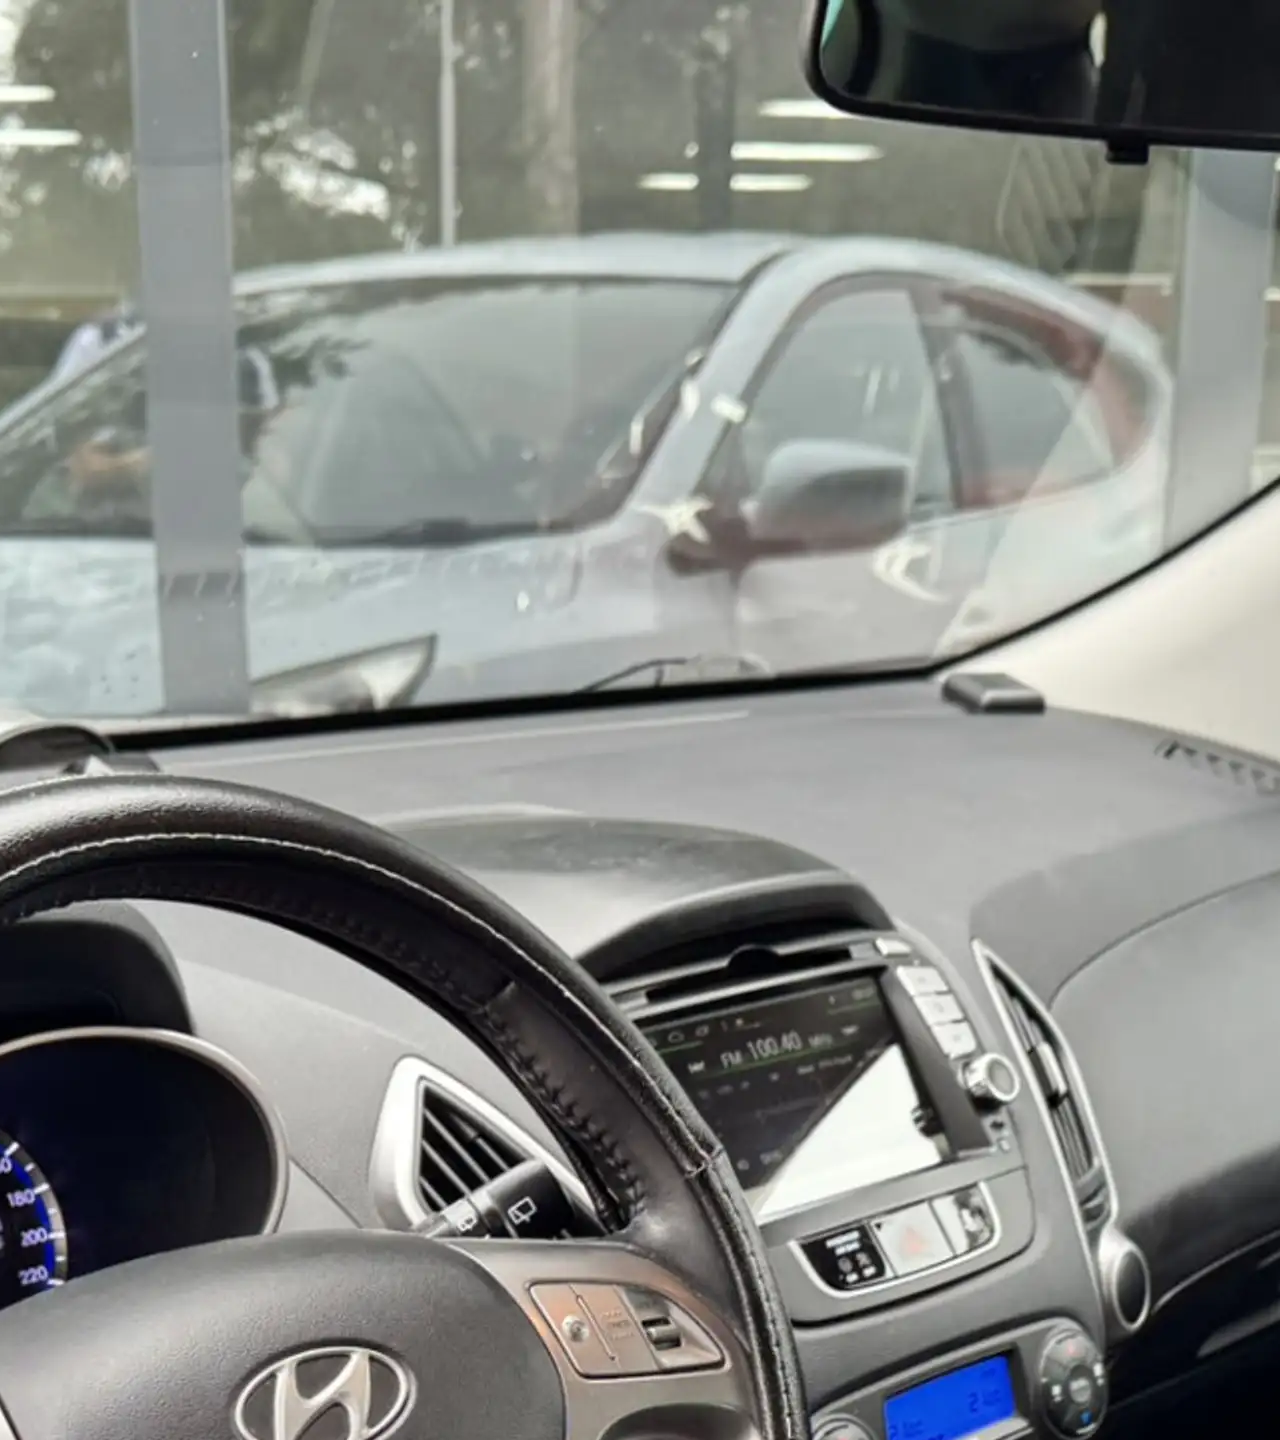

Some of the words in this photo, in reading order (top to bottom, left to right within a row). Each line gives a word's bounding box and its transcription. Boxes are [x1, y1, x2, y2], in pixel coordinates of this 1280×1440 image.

[6, 1188, 36, 1208] 180
[21, 1227, 48, 1247] 200
[18, 1266, 49, 1286] 220
